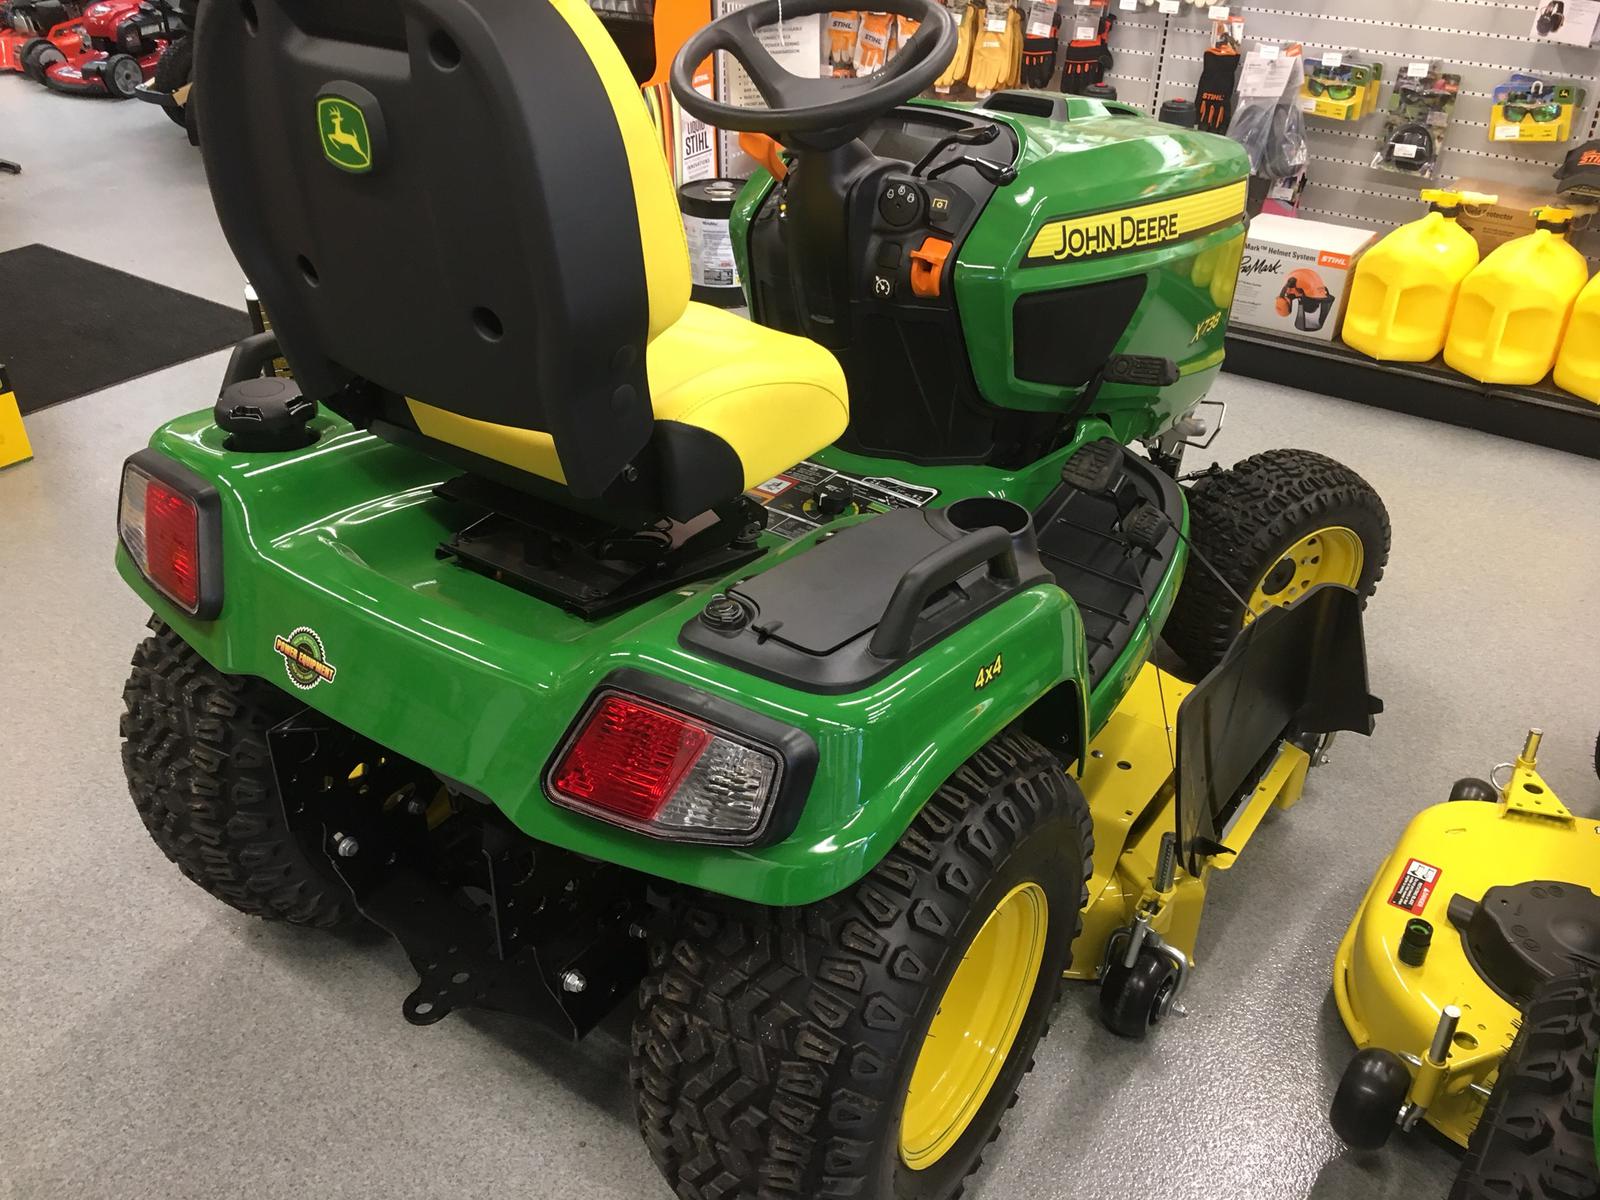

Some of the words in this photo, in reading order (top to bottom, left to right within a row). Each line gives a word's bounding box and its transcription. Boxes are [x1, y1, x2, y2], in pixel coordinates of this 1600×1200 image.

[832, 20, 853, 29] STIHL
[864, 33, 883, 45] STIHL
[1201, 92, 1224, 101] STIHL
[685, 131, 709, 156] STIHL
[1054, 224, 1116, 257] JOHN
[1120, 213, 1180, 246] DEERE
[1268, 247, 1292, 258] Helmet
[1292, 251, 1316, 262] System
[1321, 255, 1347, 266] STIHL
[974, 653, 1002, 688] 4x4
